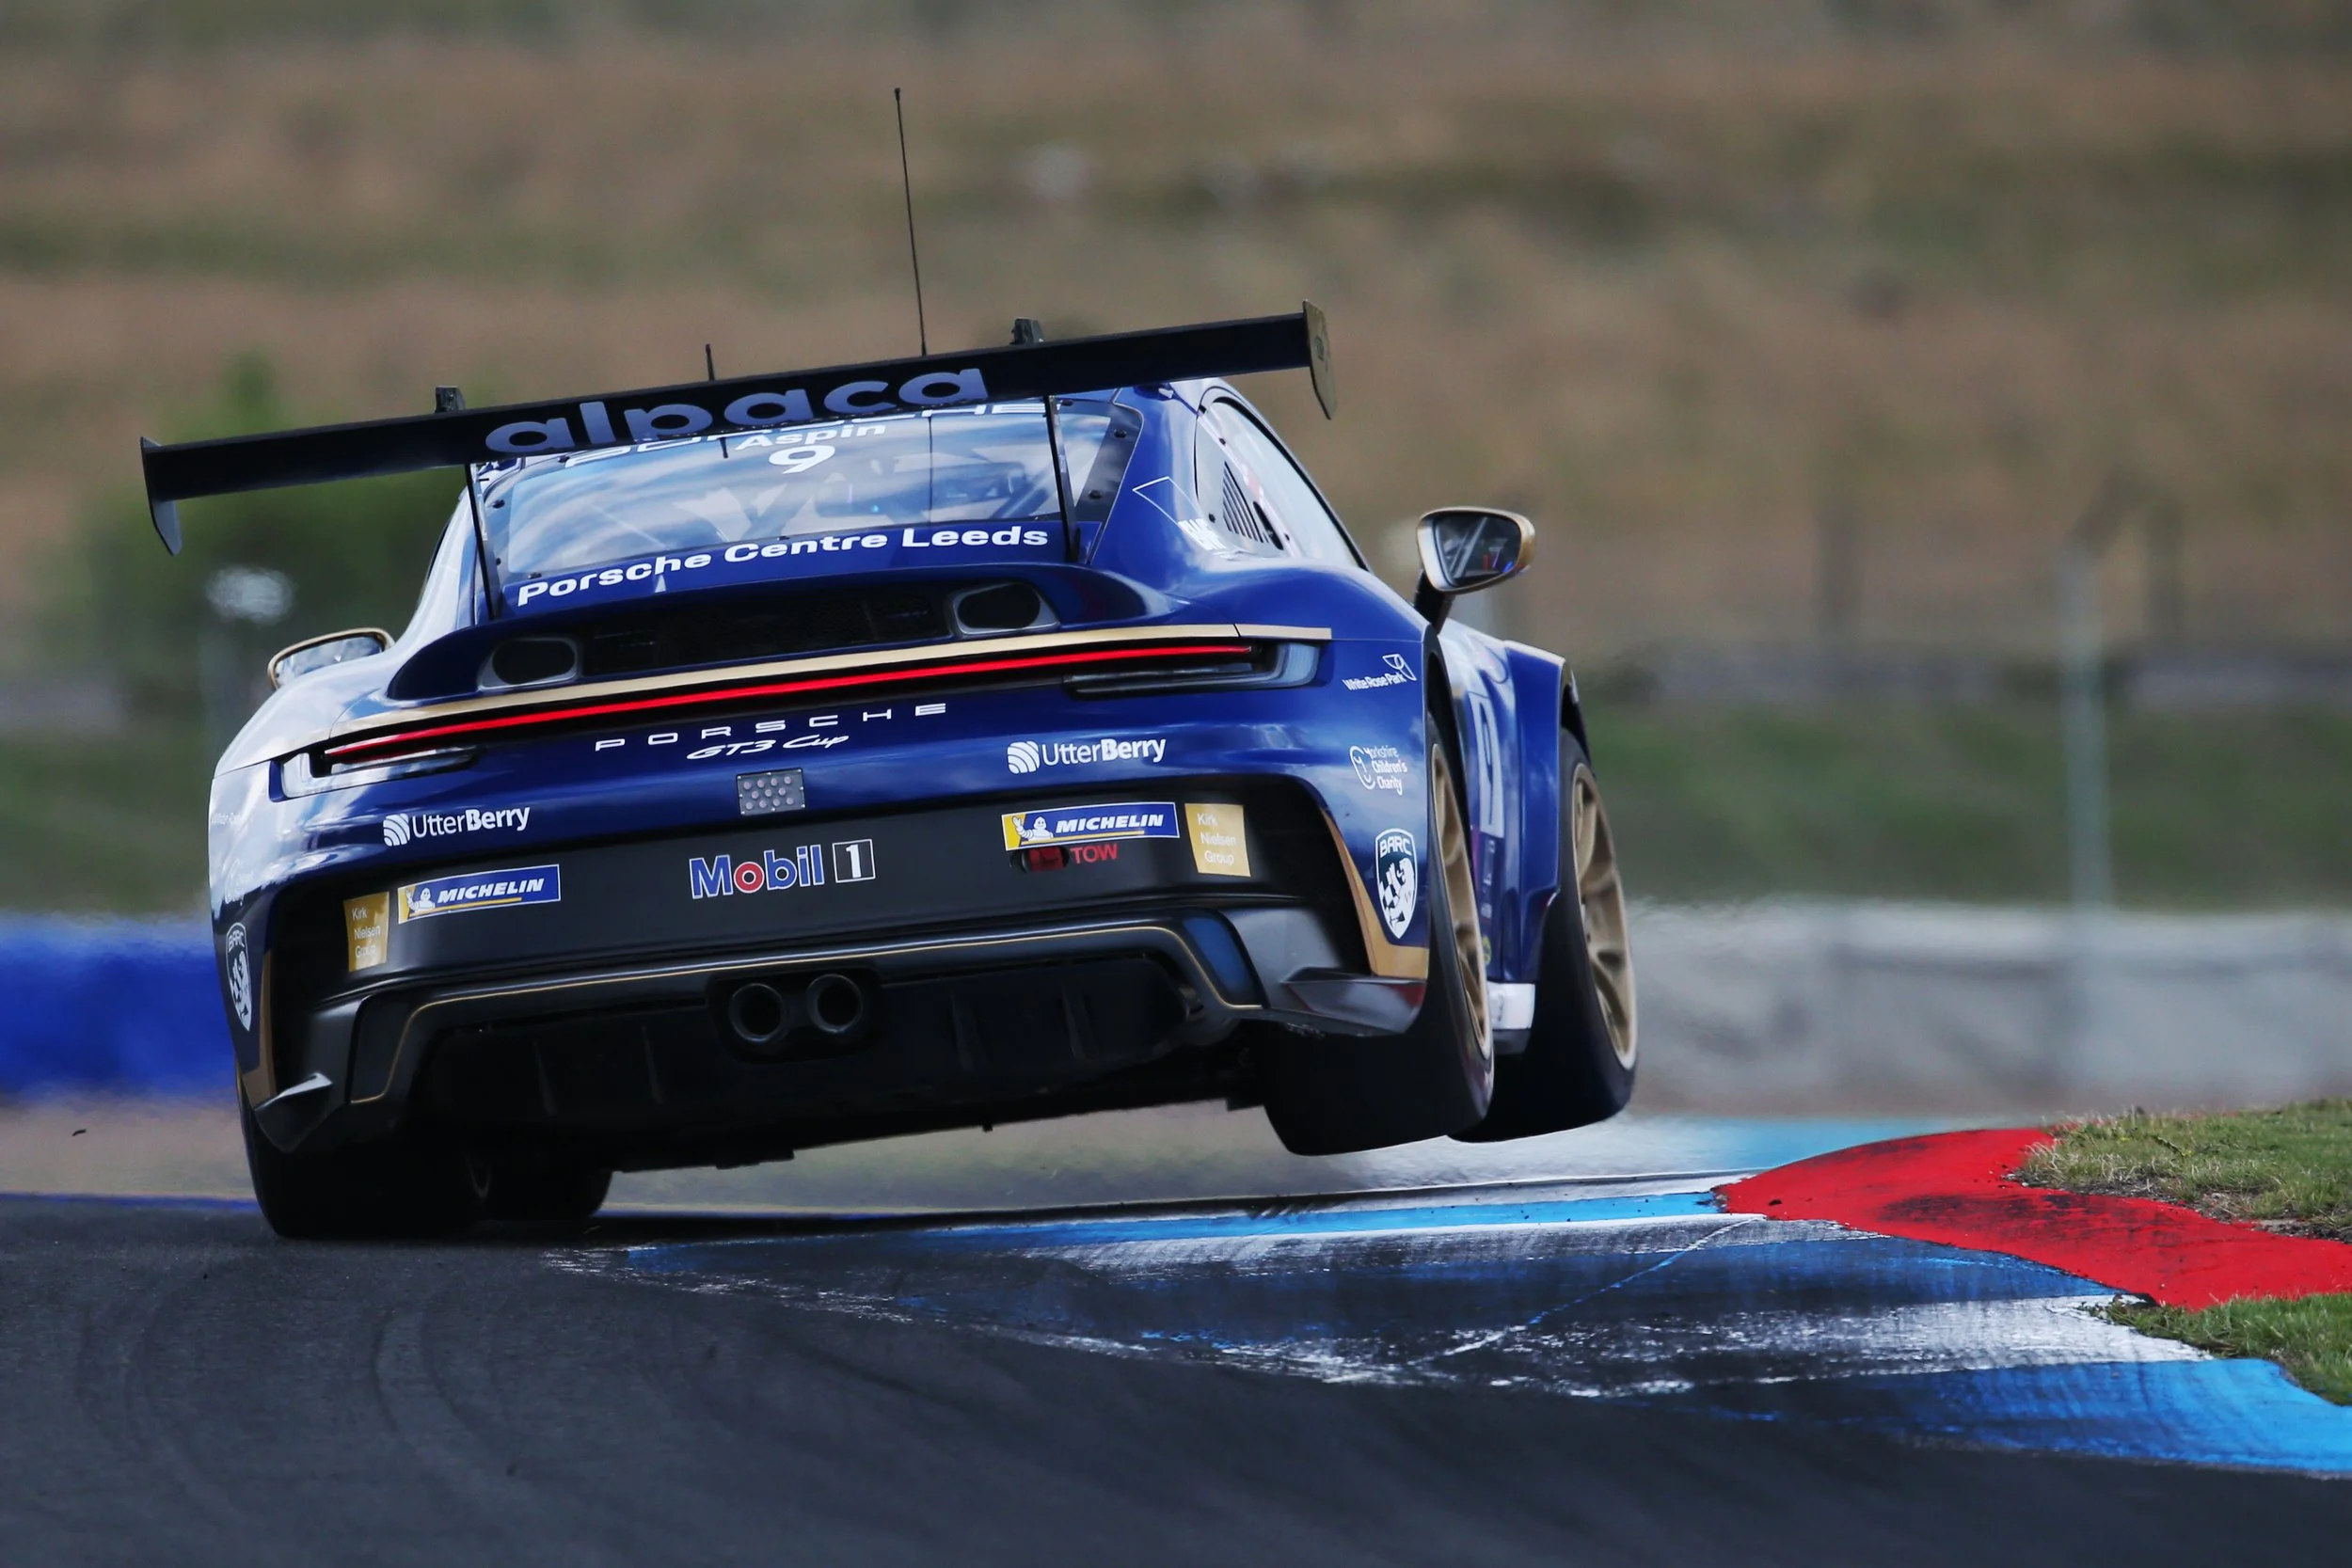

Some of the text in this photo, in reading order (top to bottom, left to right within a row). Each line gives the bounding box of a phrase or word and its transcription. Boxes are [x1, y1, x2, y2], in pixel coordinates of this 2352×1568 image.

[485, 368, 988, 453] alpaca
[734, 424, 886, 451] Aspin
[769, 445, 835, 474] 9
[517, 526, 1049, 607] Porsche Centre Leeds
[1364, 676, 1389, 688] Rose
[1385, 673, 1407, 685] Park
[595, 703, 946, 752] PORSCHE
[687, 735, 849, 759] GT3 Cup
[1041, 738, 1166, 766] UtterBerry
[412, 807, 531, 838] UtterBerry
[1056, 814, 1164, 833] MICHELIN
[1197, 813, 1218, 826] Kirk
[1200, 832, 1237, 847] Nielsen
[1379, 835, 1412, 859] BARC
[1070, 843, 1119, 864] TOW
[1204, 849, 1235, 866] Group
[689, 845, 825, 899] Mobil
[437, 879, 544, 904] MICHELIN
[352, 907, 368, 921] Kirk
[354, 925, 381, 941] Nielsen
